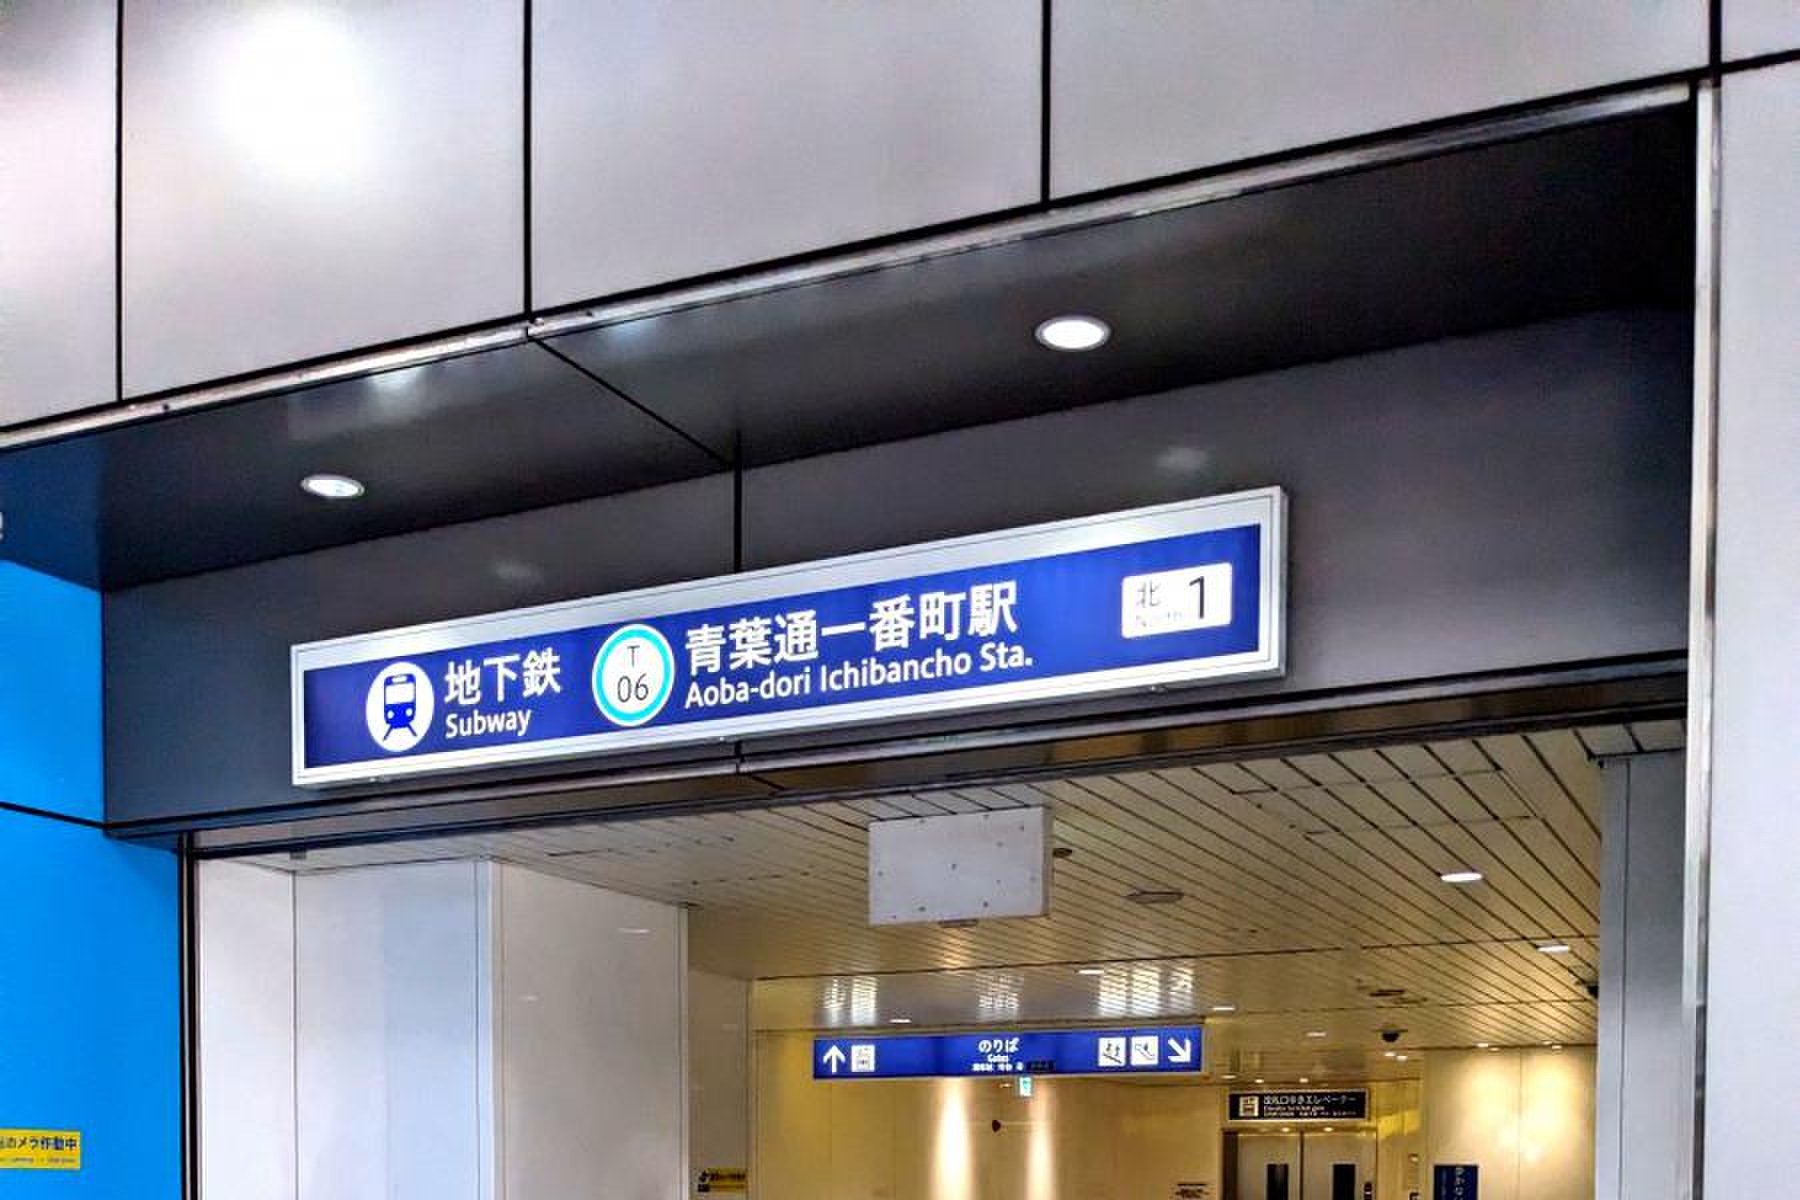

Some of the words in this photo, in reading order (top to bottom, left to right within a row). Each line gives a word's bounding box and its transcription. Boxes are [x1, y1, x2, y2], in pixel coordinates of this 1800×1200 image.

[1188, 575, 1205, 620] 1
[685, 580, 1018, 675] 青葉通一番町駅
[627, 644, 641, 668] T
[685, 670, 811, 709] Aoba-dori
[820, 650, 972, 692] Ichibancho
[979, 641, 1034, 672] Sta.
[444, 647, 562, 706] 地下鉄
[616, 674, 650, 704] 06
[445, 707, 533, 740] Subway
[978, 1037, 1020, 1053] のりば
